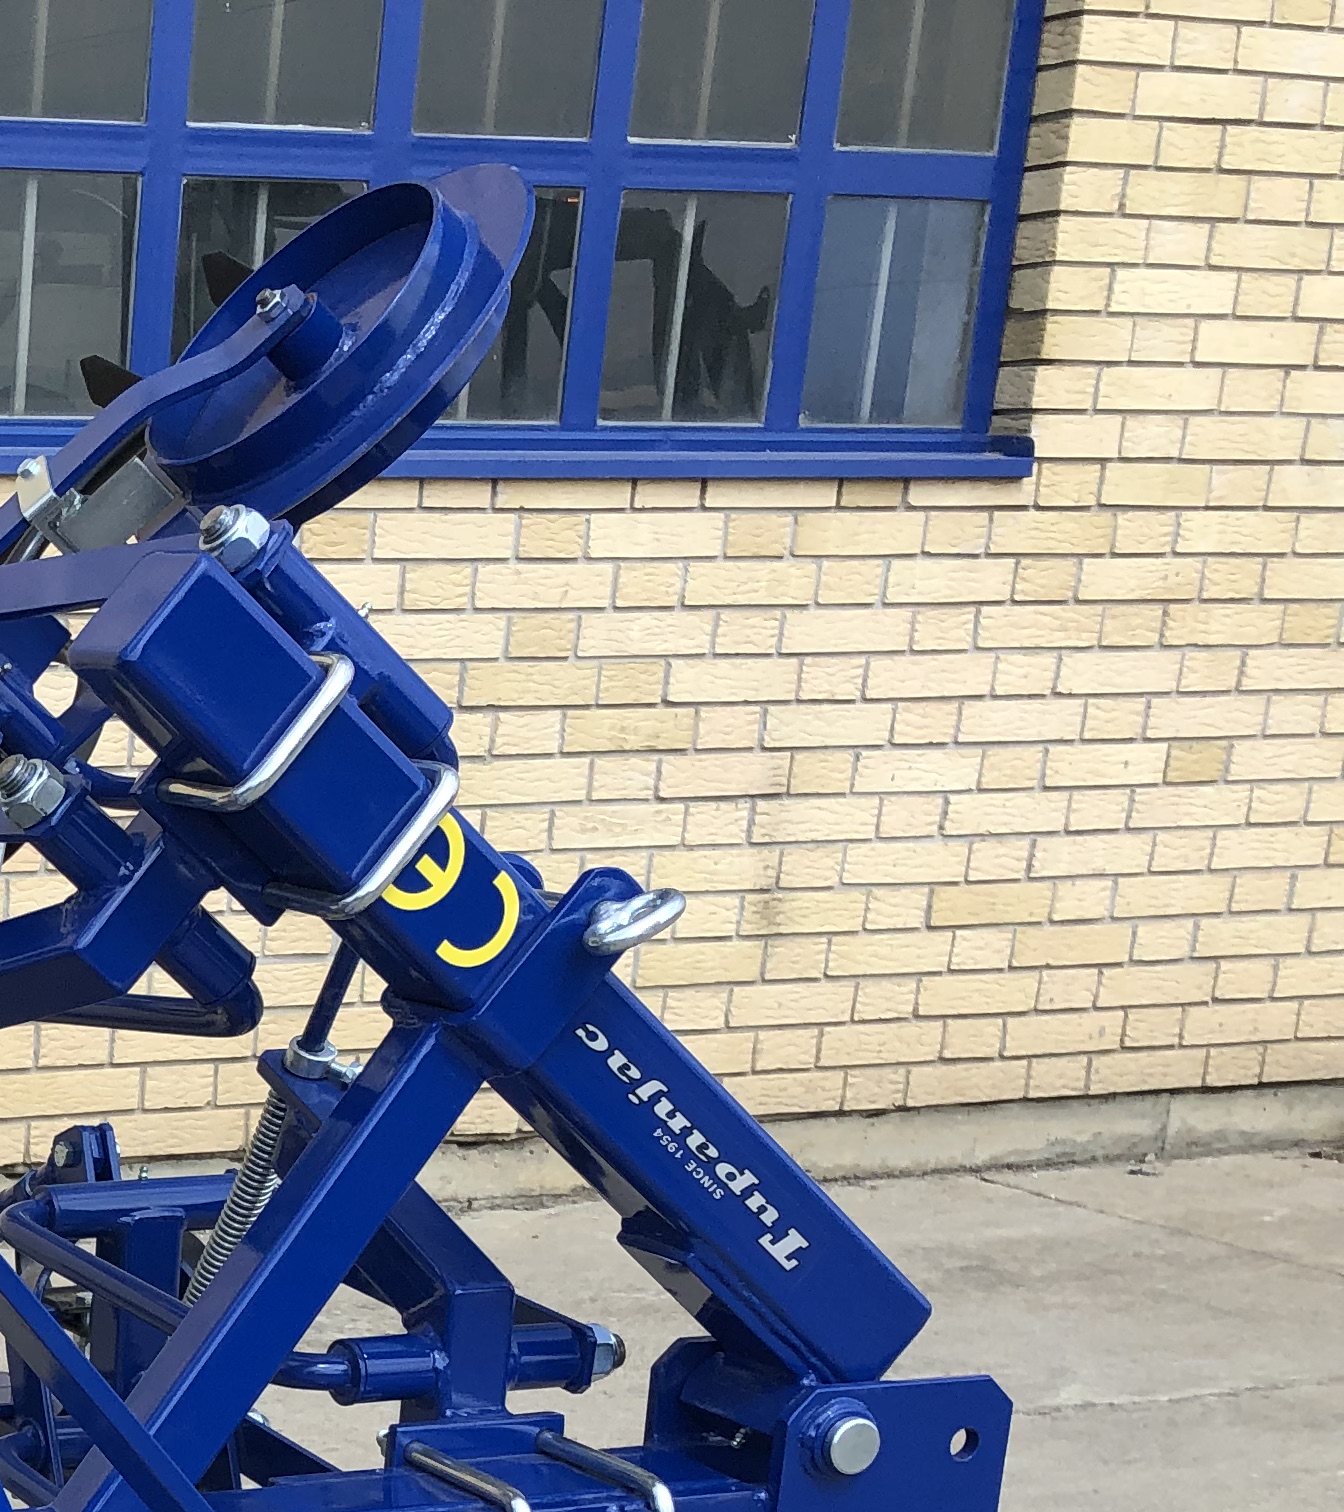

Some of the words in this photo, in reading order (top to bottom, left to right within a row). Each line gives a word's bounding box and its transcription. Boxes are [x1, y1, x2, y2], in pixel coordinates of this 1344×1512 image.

[575, 1023, 810, 1271] Tupanjac
[652, 1127, 684, 1159] 1954
[684, 1159, 725, 1200] SINCE
